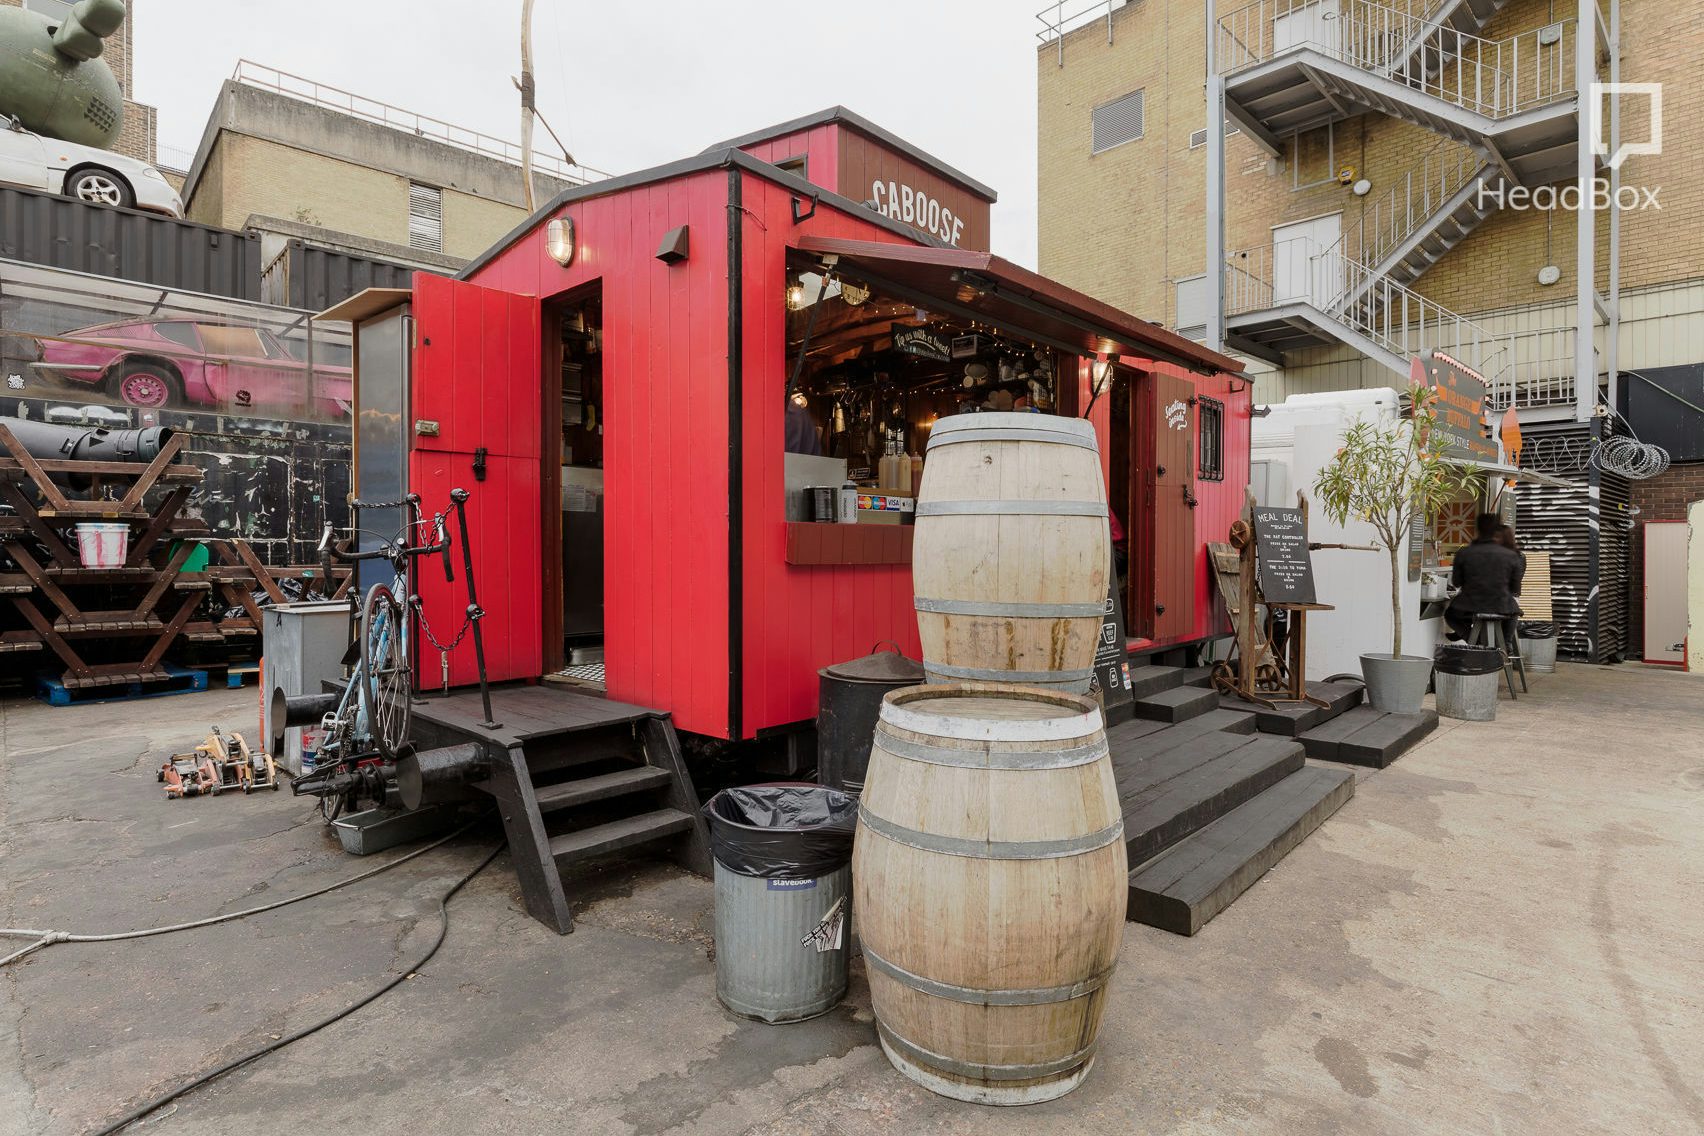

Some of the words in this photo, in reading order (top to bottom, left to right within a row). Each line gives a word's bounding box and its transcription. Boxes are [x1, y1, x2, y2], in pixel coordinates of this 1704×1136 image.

[872, 180, 964, 247] CABOOSE
[1456, 434, 1470, 450] STYLE
[1258, 512, 1278, 522] MEAL
[1282, 514, 1302, 524] DEAL
